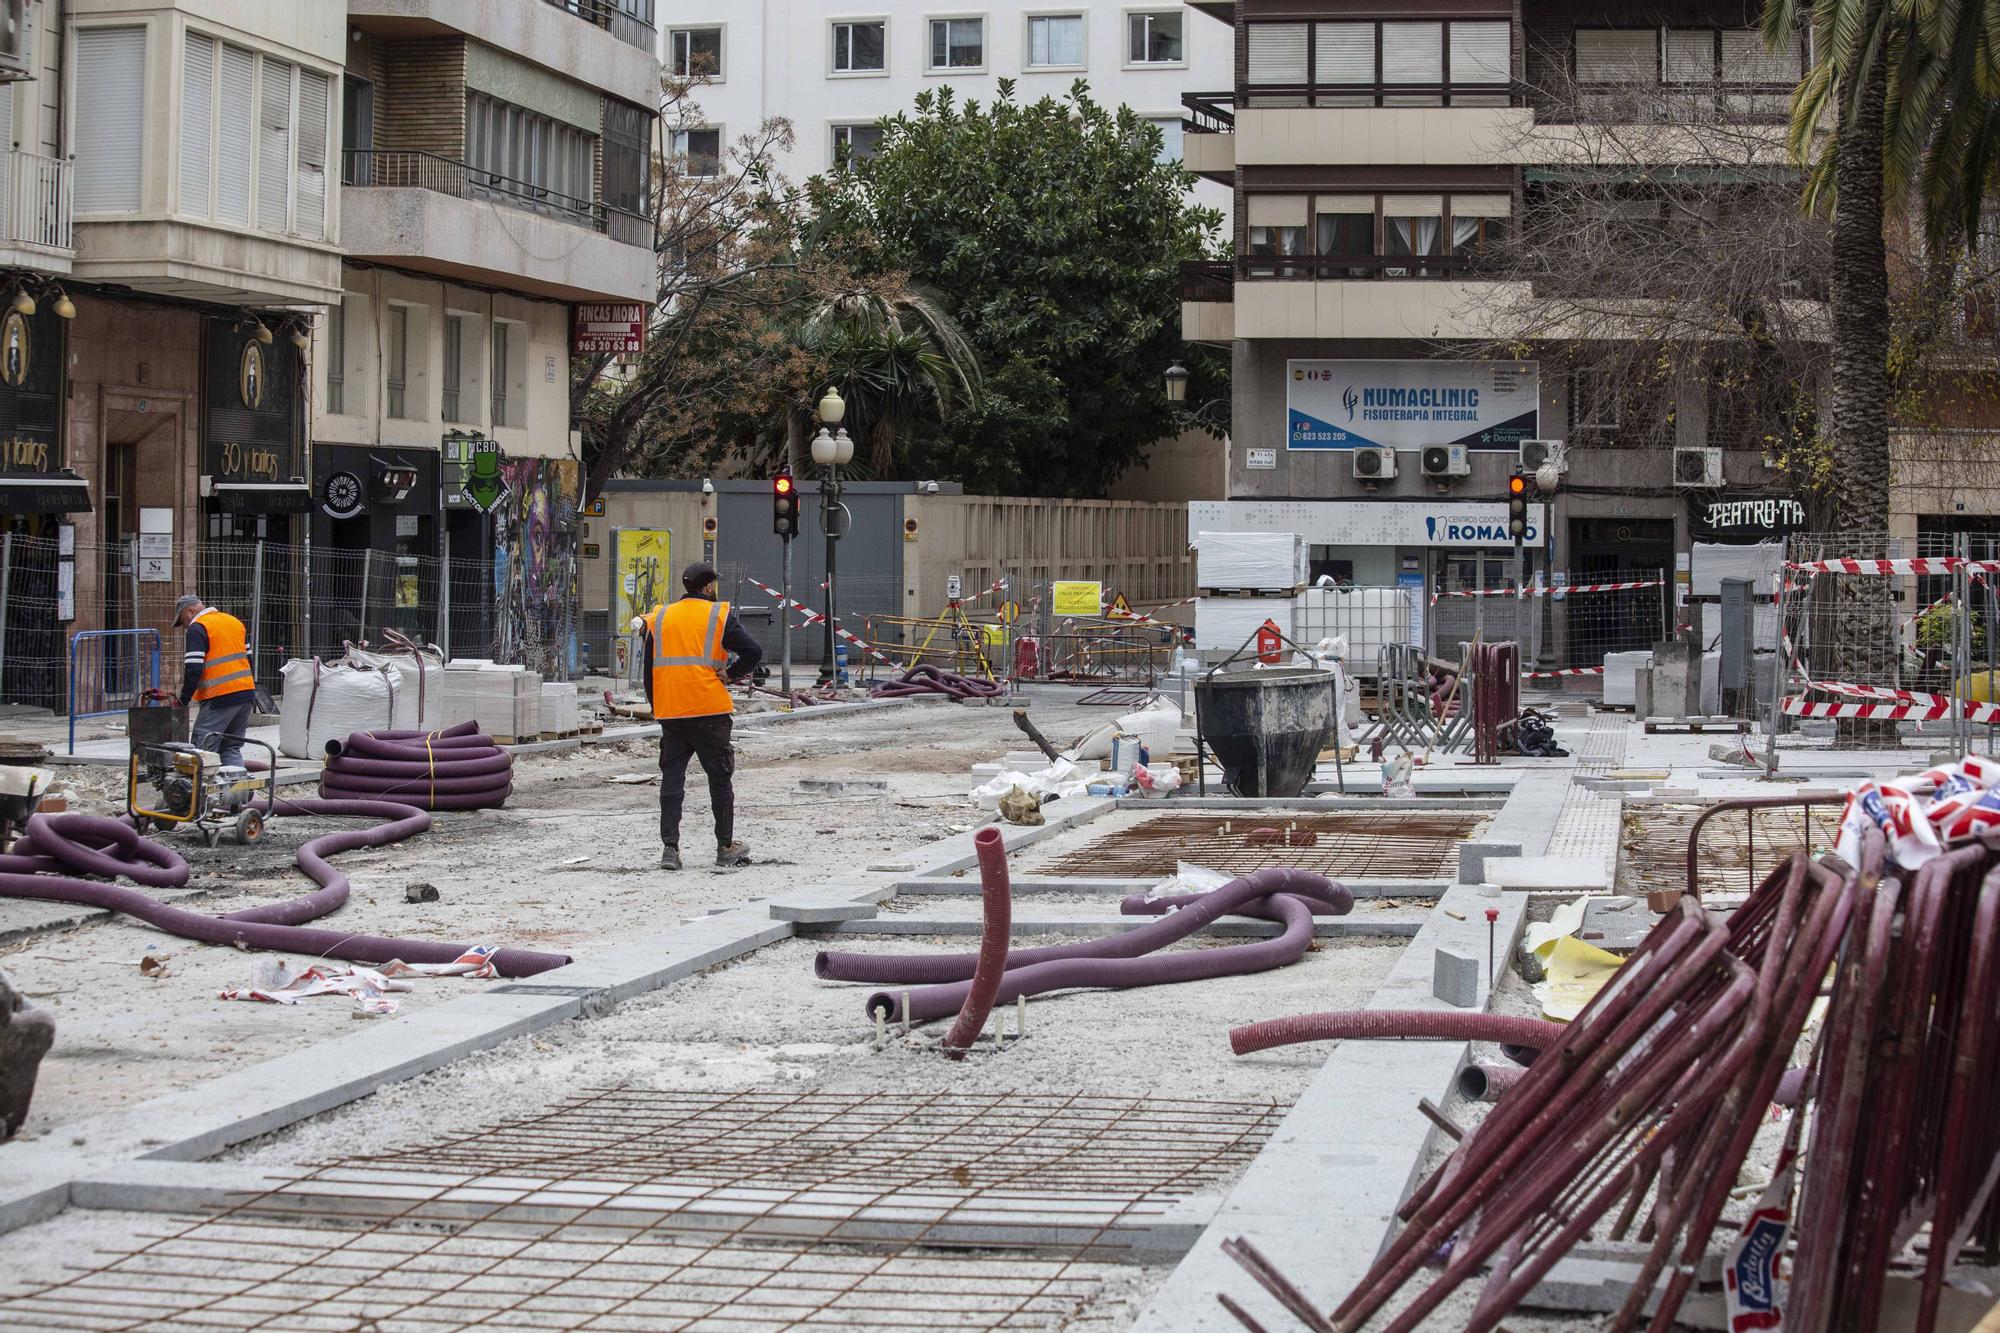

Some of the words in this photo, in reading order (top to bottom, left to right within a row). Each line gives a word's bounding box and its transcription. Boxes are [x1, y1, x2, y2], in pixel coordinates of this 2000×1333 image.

[578, 306, 611, 322] FINCAS
[612, 306, 640, 322] MORA
[578, 341, 596, 351] 965
[598, 341, 611, 351] 20
[612, 341, 625, 351] 63
[627, 341, 639, 351] 88
[1363, 388, 1479, 408] NUMACLINIC
[1363, 409, 1429, 421] FISIOTERAPIA
[1432, 409, 1479, 421] INTEGRAL
[1302, 432, 1316, 441] 623
[1317, 432, 1332, 441] 523
[1332, 432, 1346, 441] 205
[476, 441, 496, 452] CBD
[222, 443, 241, 476] 30
[462, 489, 484, 514] DOCTOR
[487, 489, 510, 514] AMNESIA
[595, 502, 602, 512] P
